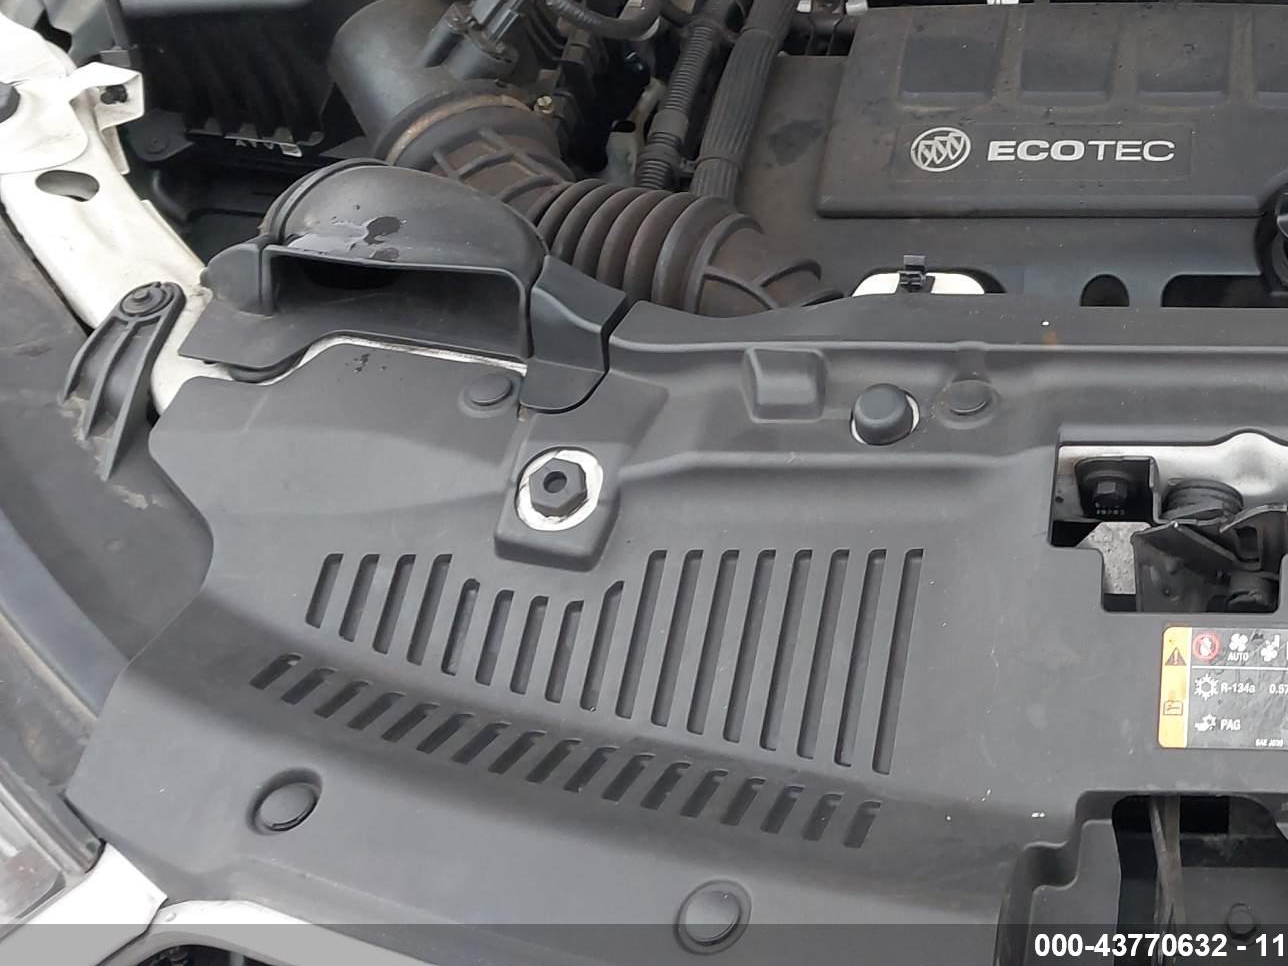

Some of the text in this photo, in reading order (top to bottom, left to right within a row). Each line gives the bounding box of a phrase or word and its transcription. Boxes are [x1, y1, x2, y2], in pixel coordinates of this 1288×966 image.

[986, 140, 1176, 162] ECOTEC
[1227, 652, 1249, 661] AUTO
[1220, 682, 1256, 693] R-134a
[1220, 719, 1241, 731] PAG
